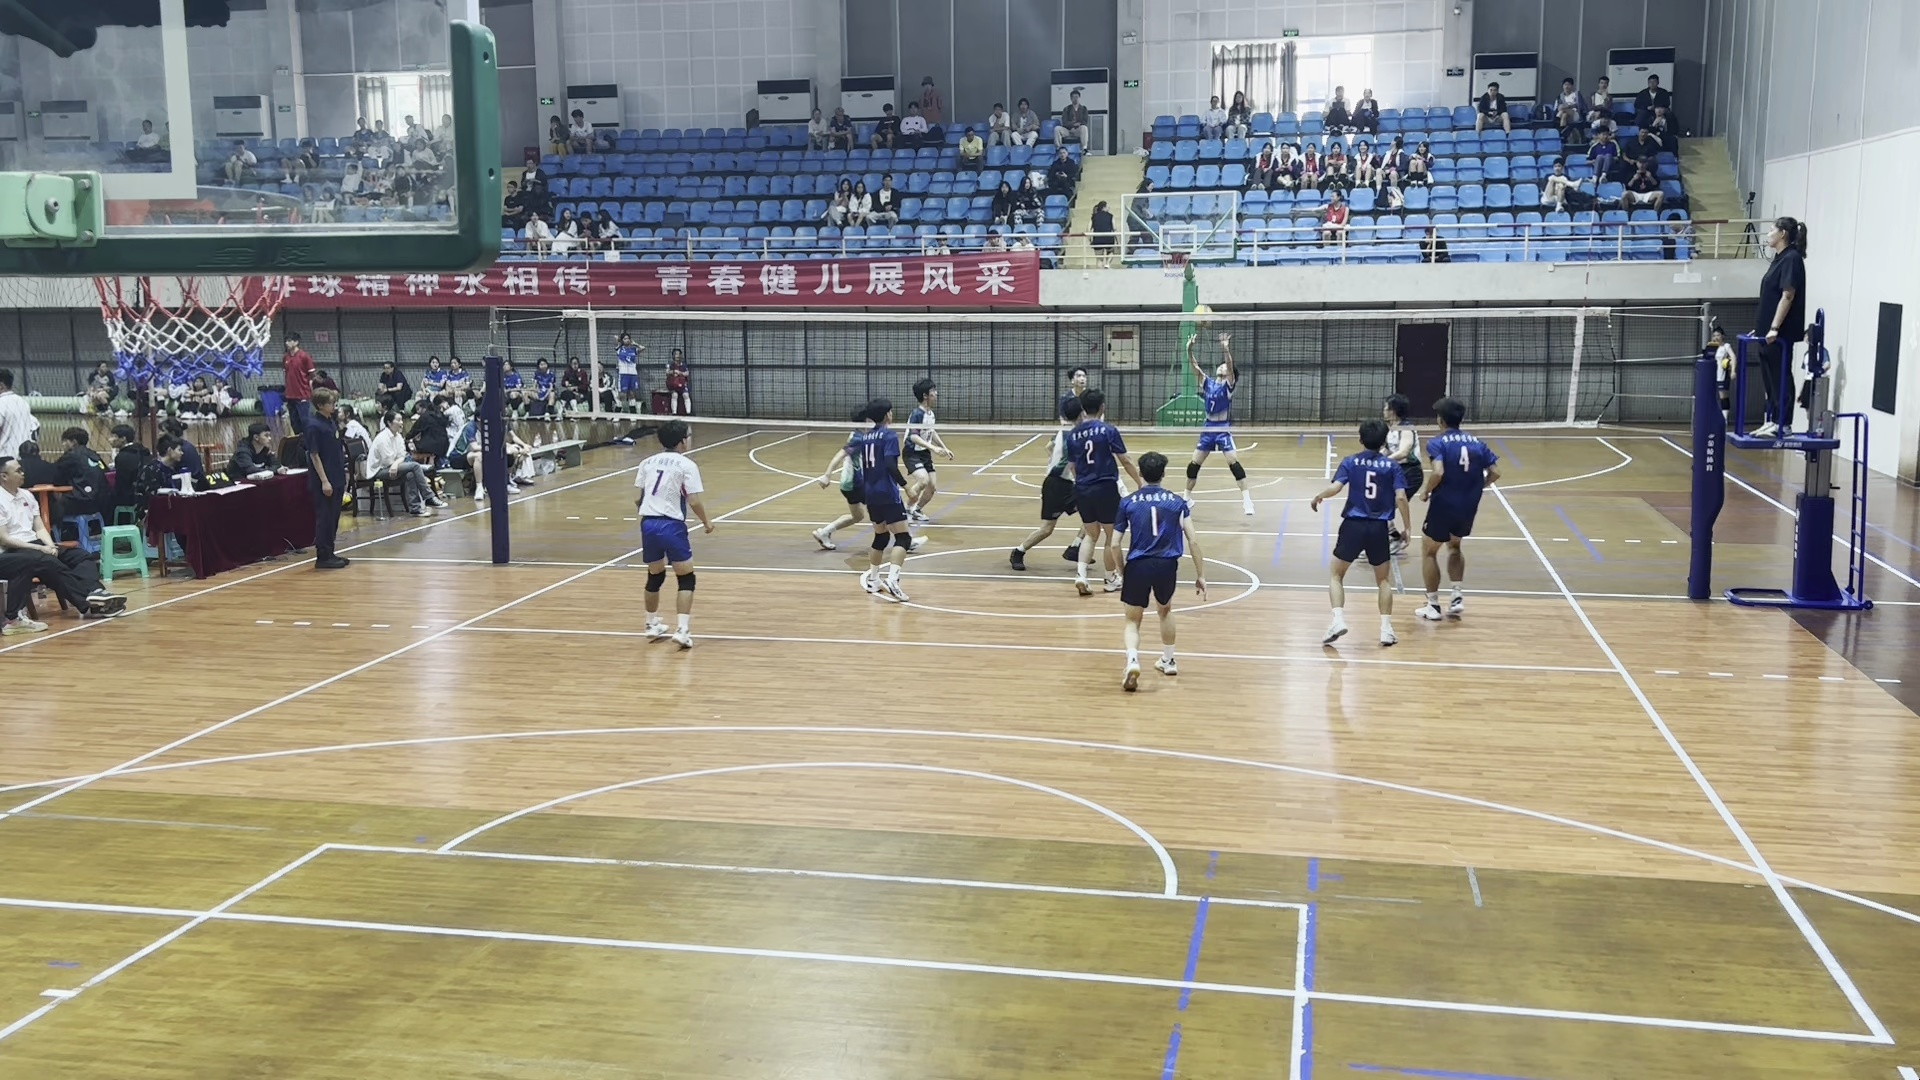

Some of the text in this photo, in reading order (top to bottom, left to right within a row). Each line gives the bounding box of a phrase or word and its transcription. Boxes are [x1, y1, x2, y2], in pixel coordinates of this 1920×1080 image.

[865, 443, 876, 468] 14
[1084, 440, 1095, 464] 2
[1459, 446, 1470, 472] 4
[206, 475, 216, 484] 2
[221, 472, 229, 481] 4
[1365, 470, 1377, 499] 5
[1151, 505, 1158, 536] 1
